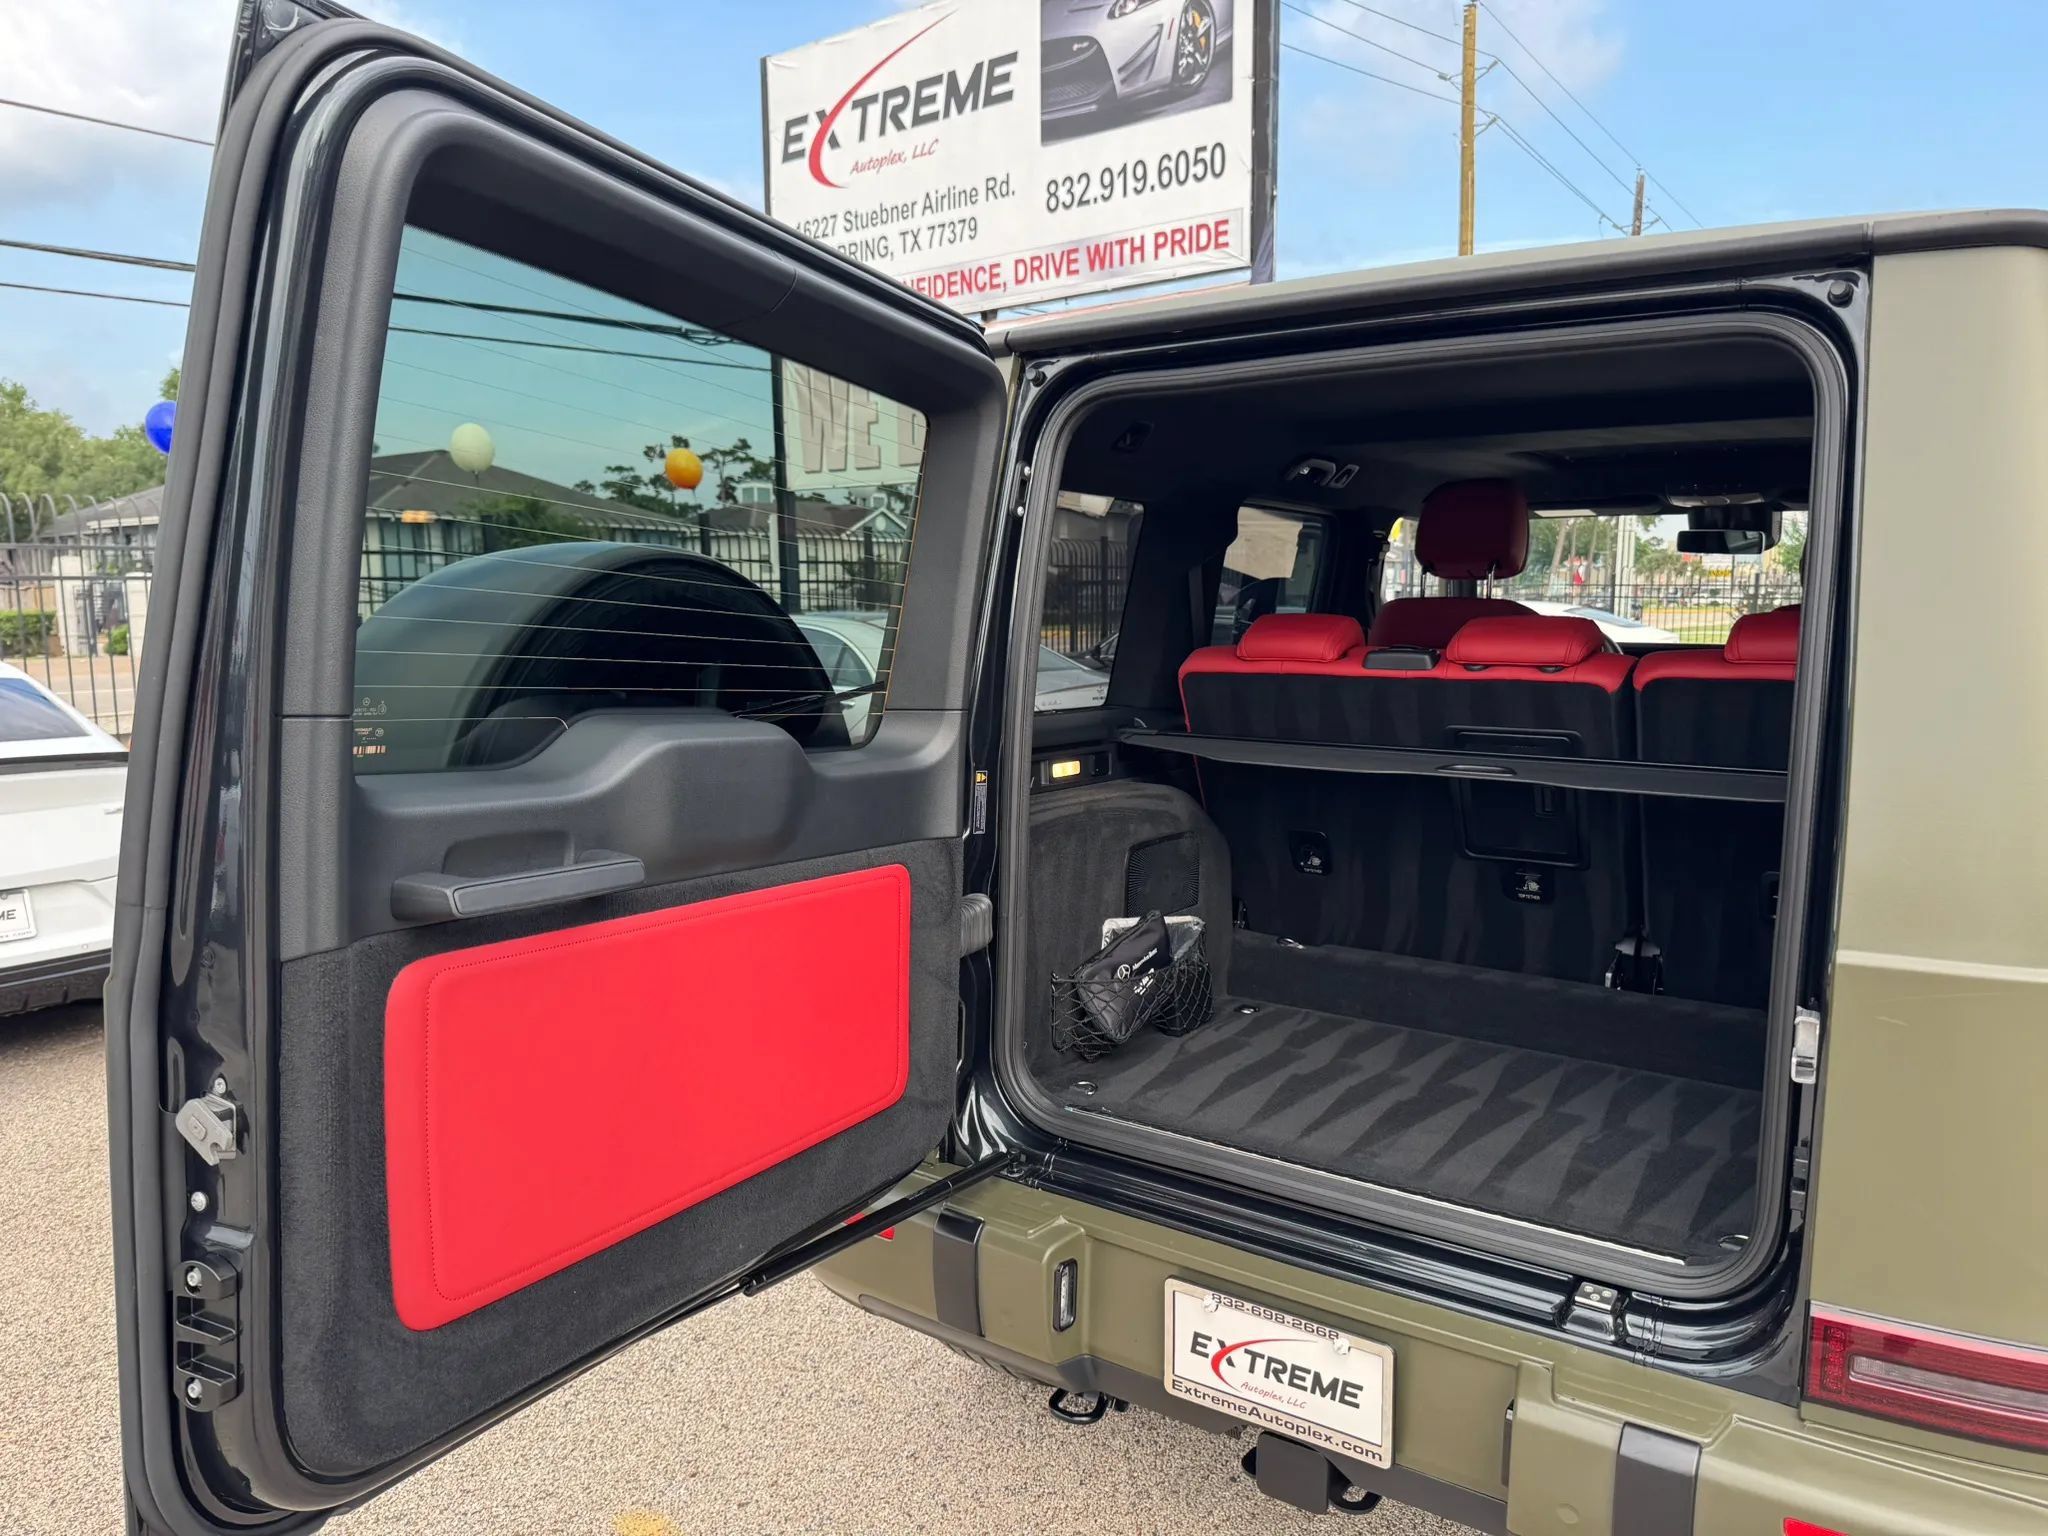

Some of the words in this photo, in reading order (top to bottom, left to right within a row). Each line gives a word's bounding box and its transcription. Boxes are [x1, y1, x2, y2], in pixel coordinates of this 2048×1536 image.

[782, 51, 1018, 164] EXTREME
[850, 150, 907, 175] Autoplex,
[912, 138, 939, 160] LLC
[1046, 142, 1226, 213] 832.919.6050
[843, 202, 917, 232] Stuebner
[922, 185, 979, 216] Airline
[985, 172, 1015, 202] Rd.
[899, 227, 922, 254] TX
[927, 216, 977, 249] 77379
[1014, 248, 1079, 285] DRIVE
[1086, 235, 1145, 272] WITH
[1154, 219, 1229, 261] PRIDE
[794, 364, 881, 473] WE
[1190, 1331, 1363, 1409] EXTREME
[1241, 1381, 1284, 1403] Autoplex,
[1287, 1396, 1307, 1409] LLC
[1171, 1379, 1383, 1461] ExtremeAutoplex.com
